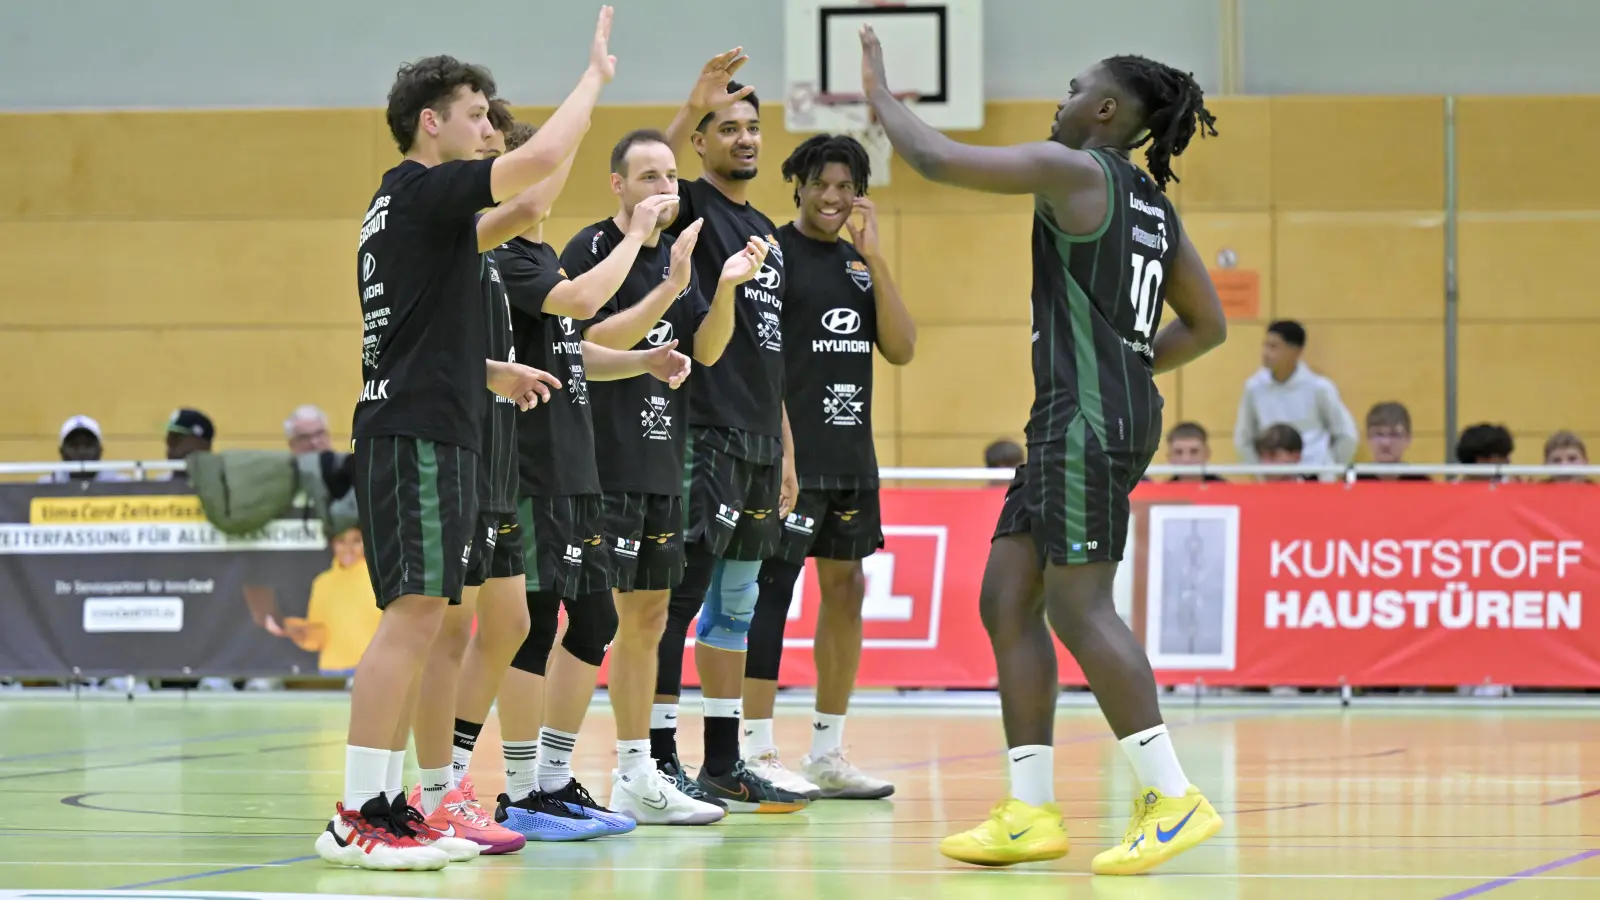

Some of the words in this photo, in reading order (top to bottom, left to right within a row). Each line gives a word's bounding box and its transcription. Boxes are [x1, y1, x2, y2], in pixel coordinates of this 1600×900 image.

[1130, 252, 1163, 338] 10
[377, 317, 388, 327] KG
[812, 340, 870, 353] HYUNDAI
[357, 379, 390, 402] ALK
[137, 524, 171, 544] FÜR
[178, 528, 217, 544] ALLE
[1087, 541, 1098, 550] 10
[1270, 539, 1584, 578] KUNSTSTOFF
[1264, 582, 1582, 629] HAUSTÜREN
